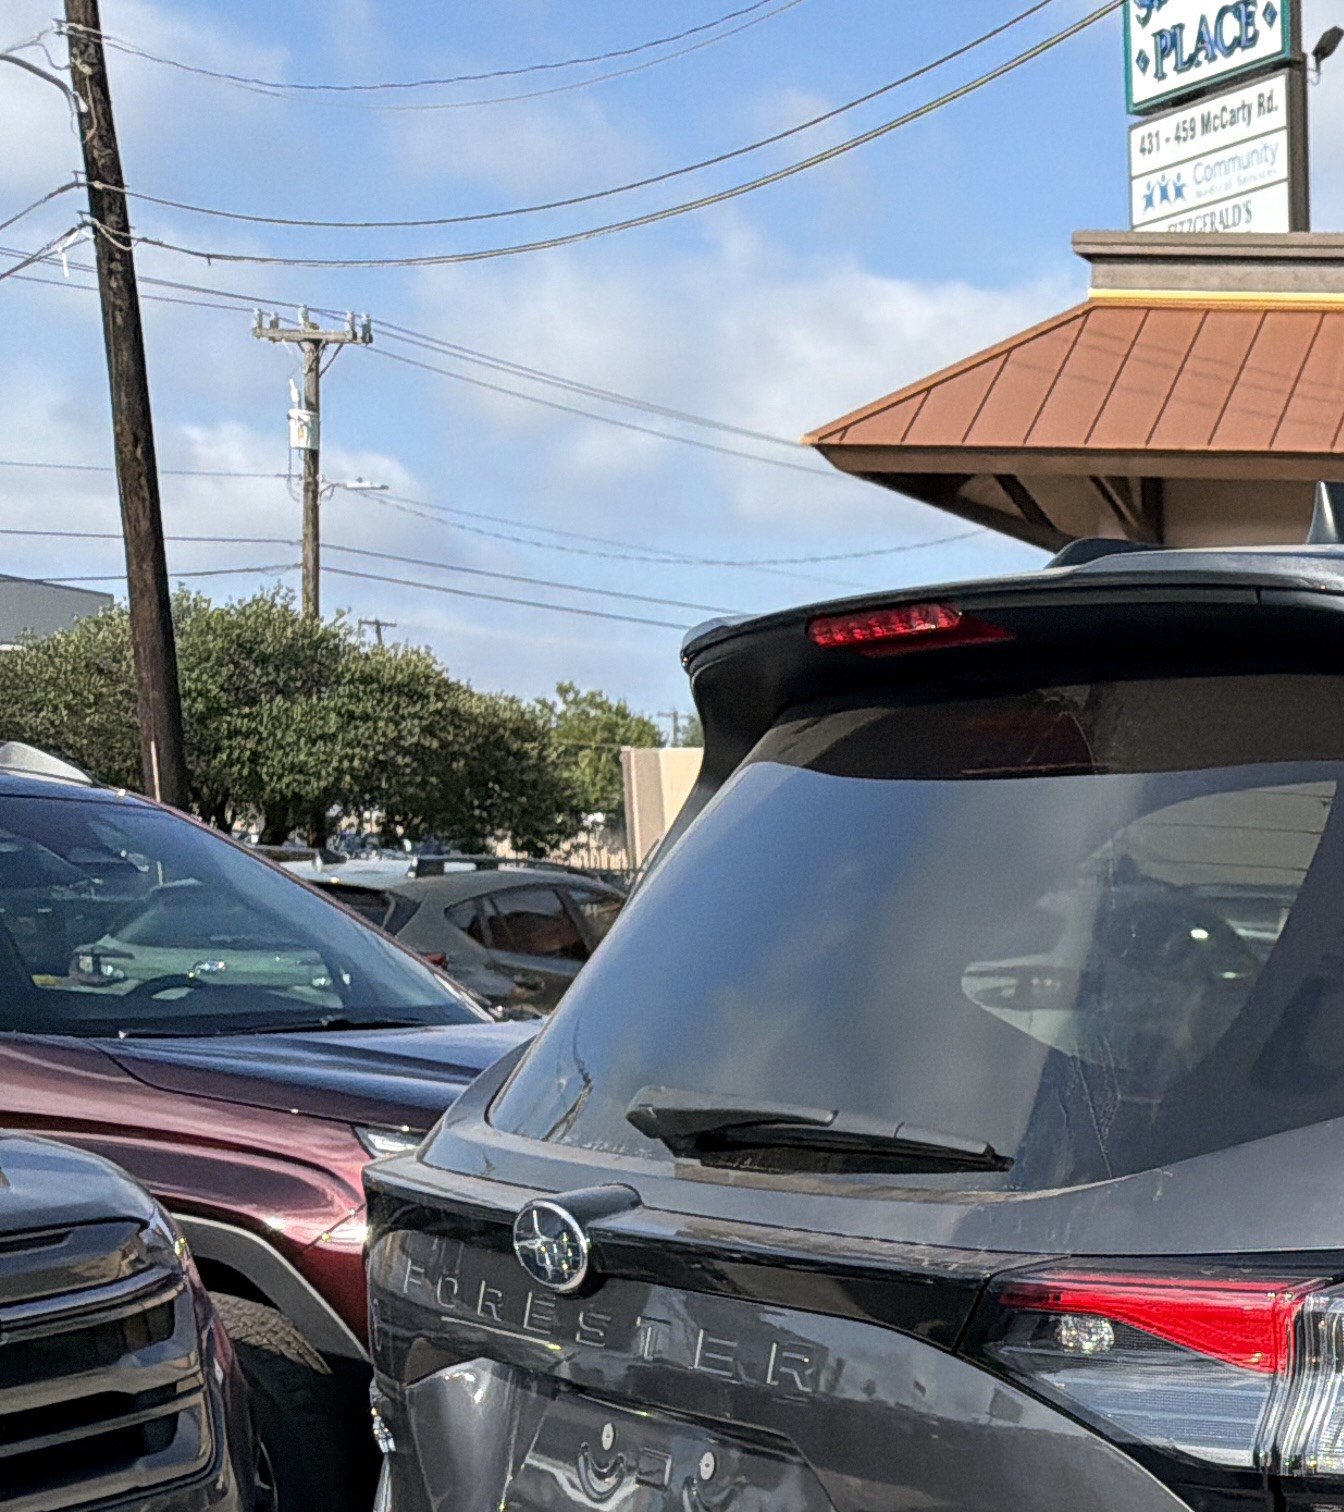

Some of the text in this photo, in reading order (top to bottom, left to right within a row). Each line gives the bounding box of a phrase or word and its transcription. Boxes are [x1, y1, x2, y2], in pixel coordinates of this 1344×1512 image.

[1152, 1, 1260, 82] PLACE
[1139, 130, 1161, 157] 431
[1174, 117, 1197, 145] 459
[1200, 99, 1254, 136] McCarty
[1256, 88, 1279, 118] Rd.
[1193, 141, 1279, 186] Community
[402, 1256, 816, 1394] FORESTER
